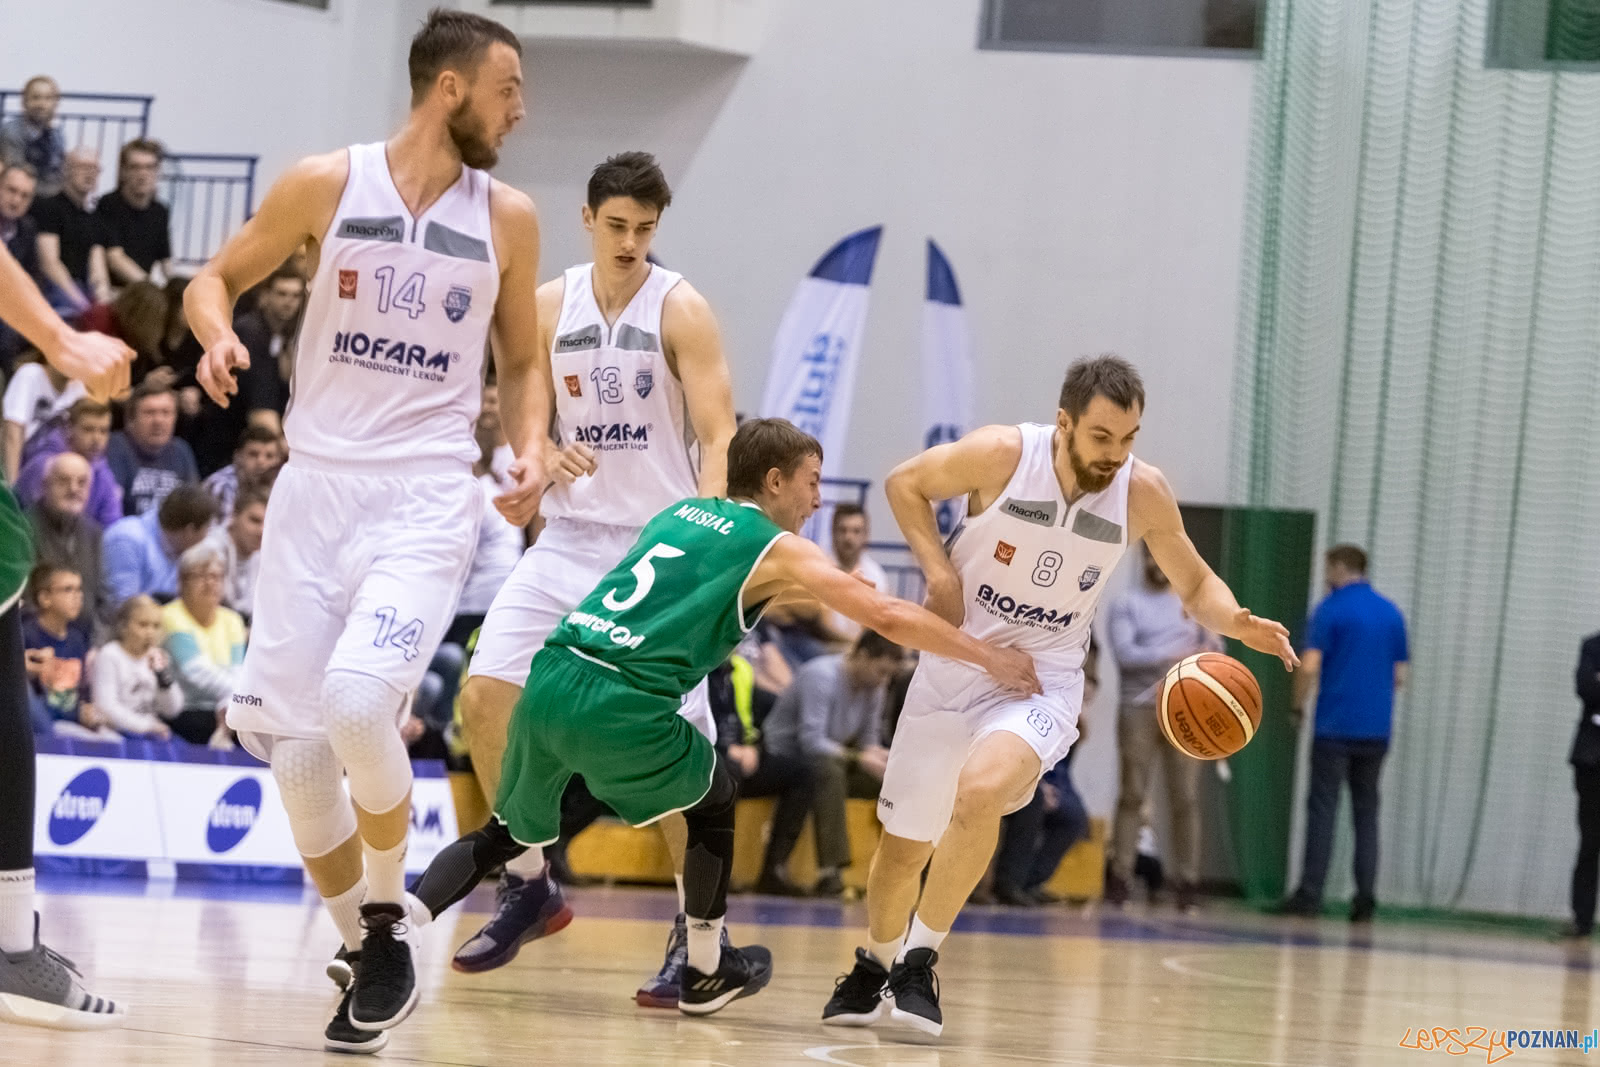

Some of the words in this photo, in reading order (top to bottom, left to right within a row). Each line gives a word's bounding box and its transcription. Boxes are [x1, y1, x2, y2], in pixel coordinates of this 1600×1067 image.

[346, 224, 400, 238] macron
[375, 265, 426, 320] 14
[560, 336, 597, 348] macron
[353, 359, 411, 377] PRODUCENT
[413, 370, 446, 383] LEKÓW
[590, 366, 624, 405] 13
[673, 503, 736, 536] MUSIAŁ
[1008, 502, 1050, 522] macron
[601, 541, 687, 612] 5
[1031, 550, 1064, 588] 8
[373, 606, 424, 662] 14
[1027, 708, 1053, 738] 8
[1175, 711, 1217, 757] molten
